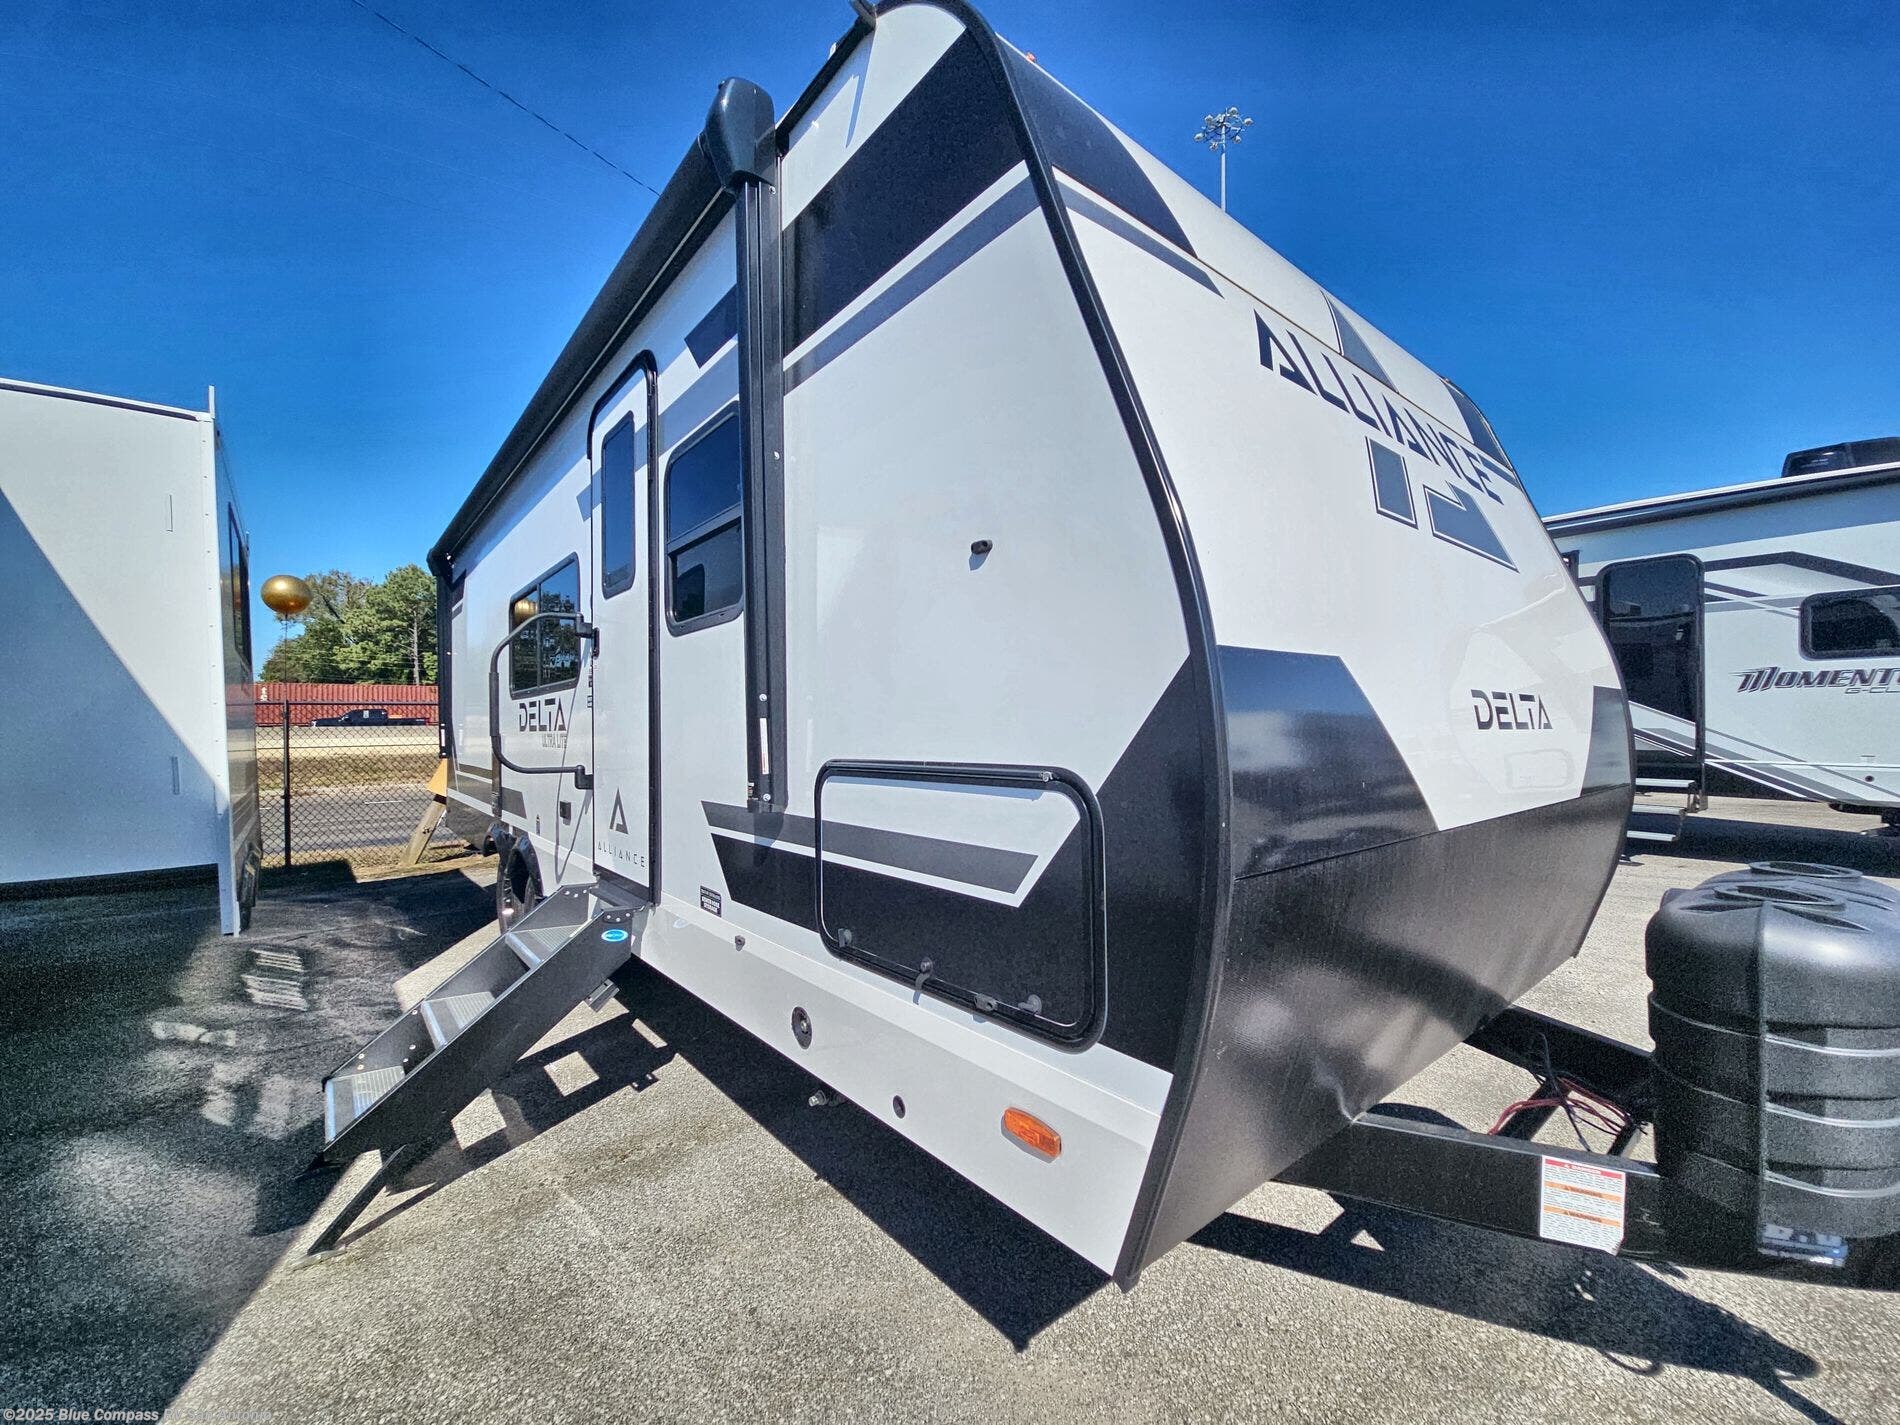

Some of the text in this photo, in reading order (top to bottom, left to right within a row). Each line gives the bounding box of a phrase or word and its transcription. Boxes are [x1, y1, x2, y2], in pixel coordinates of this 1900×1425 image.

[1253, 308, 1504, 505] ALLIANCE
[1729, 666, 1900, 693] MOMENT
[519, 697, 567, 732] DELTA
[1470, 688, 1554, 730] DELTA
[597, 840, 646, 868] ALLIANCE
